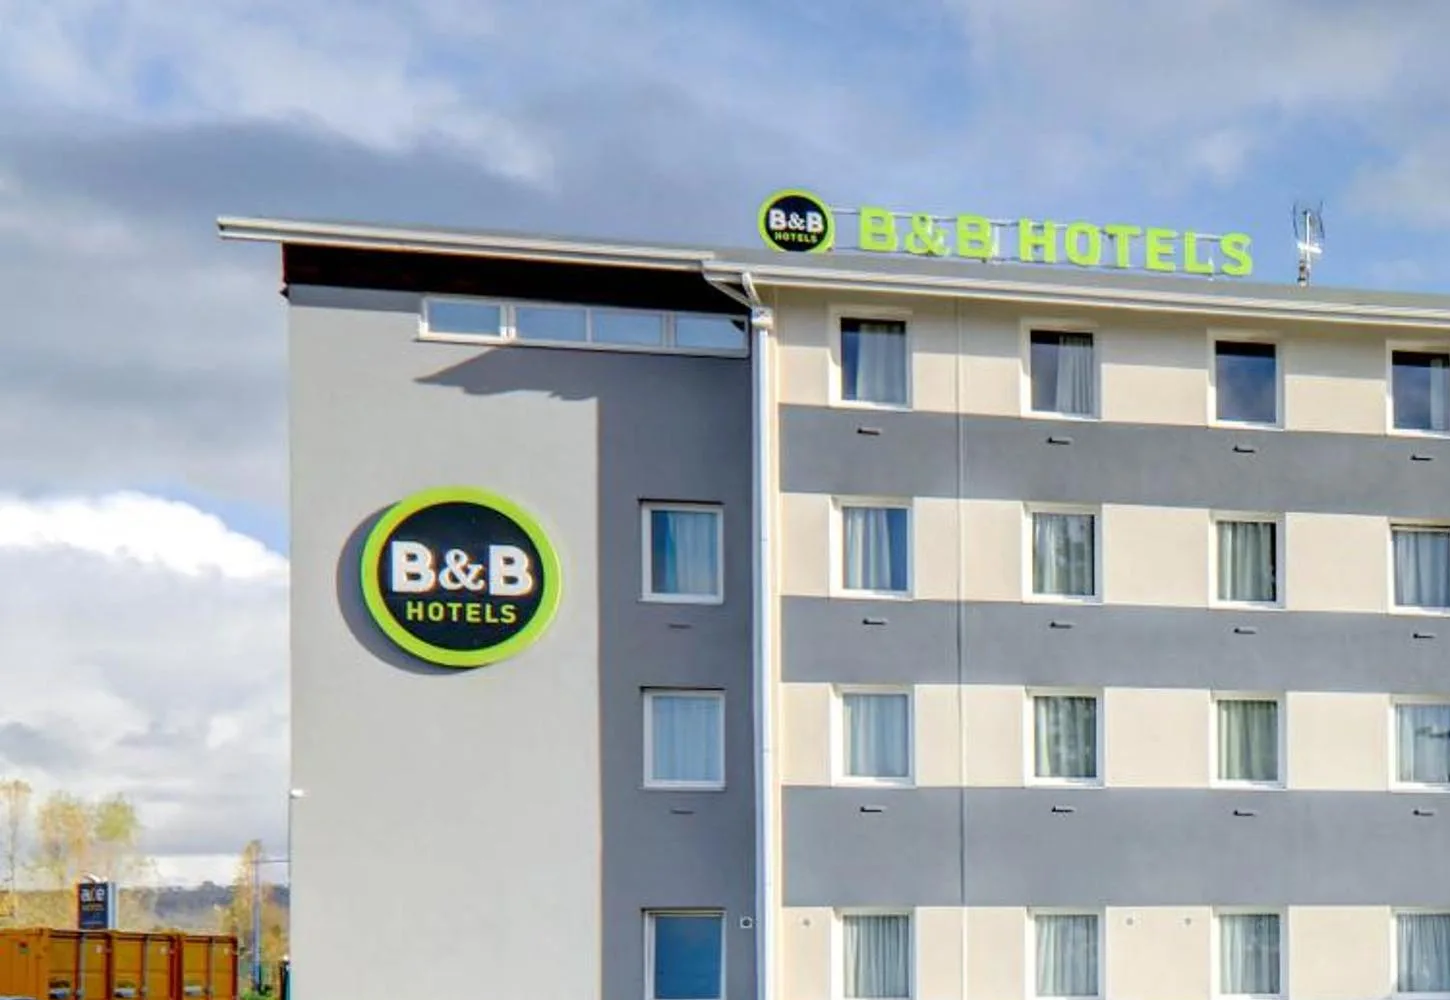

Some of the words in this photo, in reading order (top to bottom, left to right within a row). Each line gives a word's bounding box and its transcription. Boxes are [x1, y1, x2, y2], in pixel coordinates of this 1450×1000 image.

[768, 208, 824, 233] B&B
[774, 231, 818, 244] HOTELS
[859, 207, 995, 259] B&B
[1018, 217, 1252, 276] HOTELS
[391, 541, 534, 597] B&B
[406, 602, 517, 624] HOTELS
